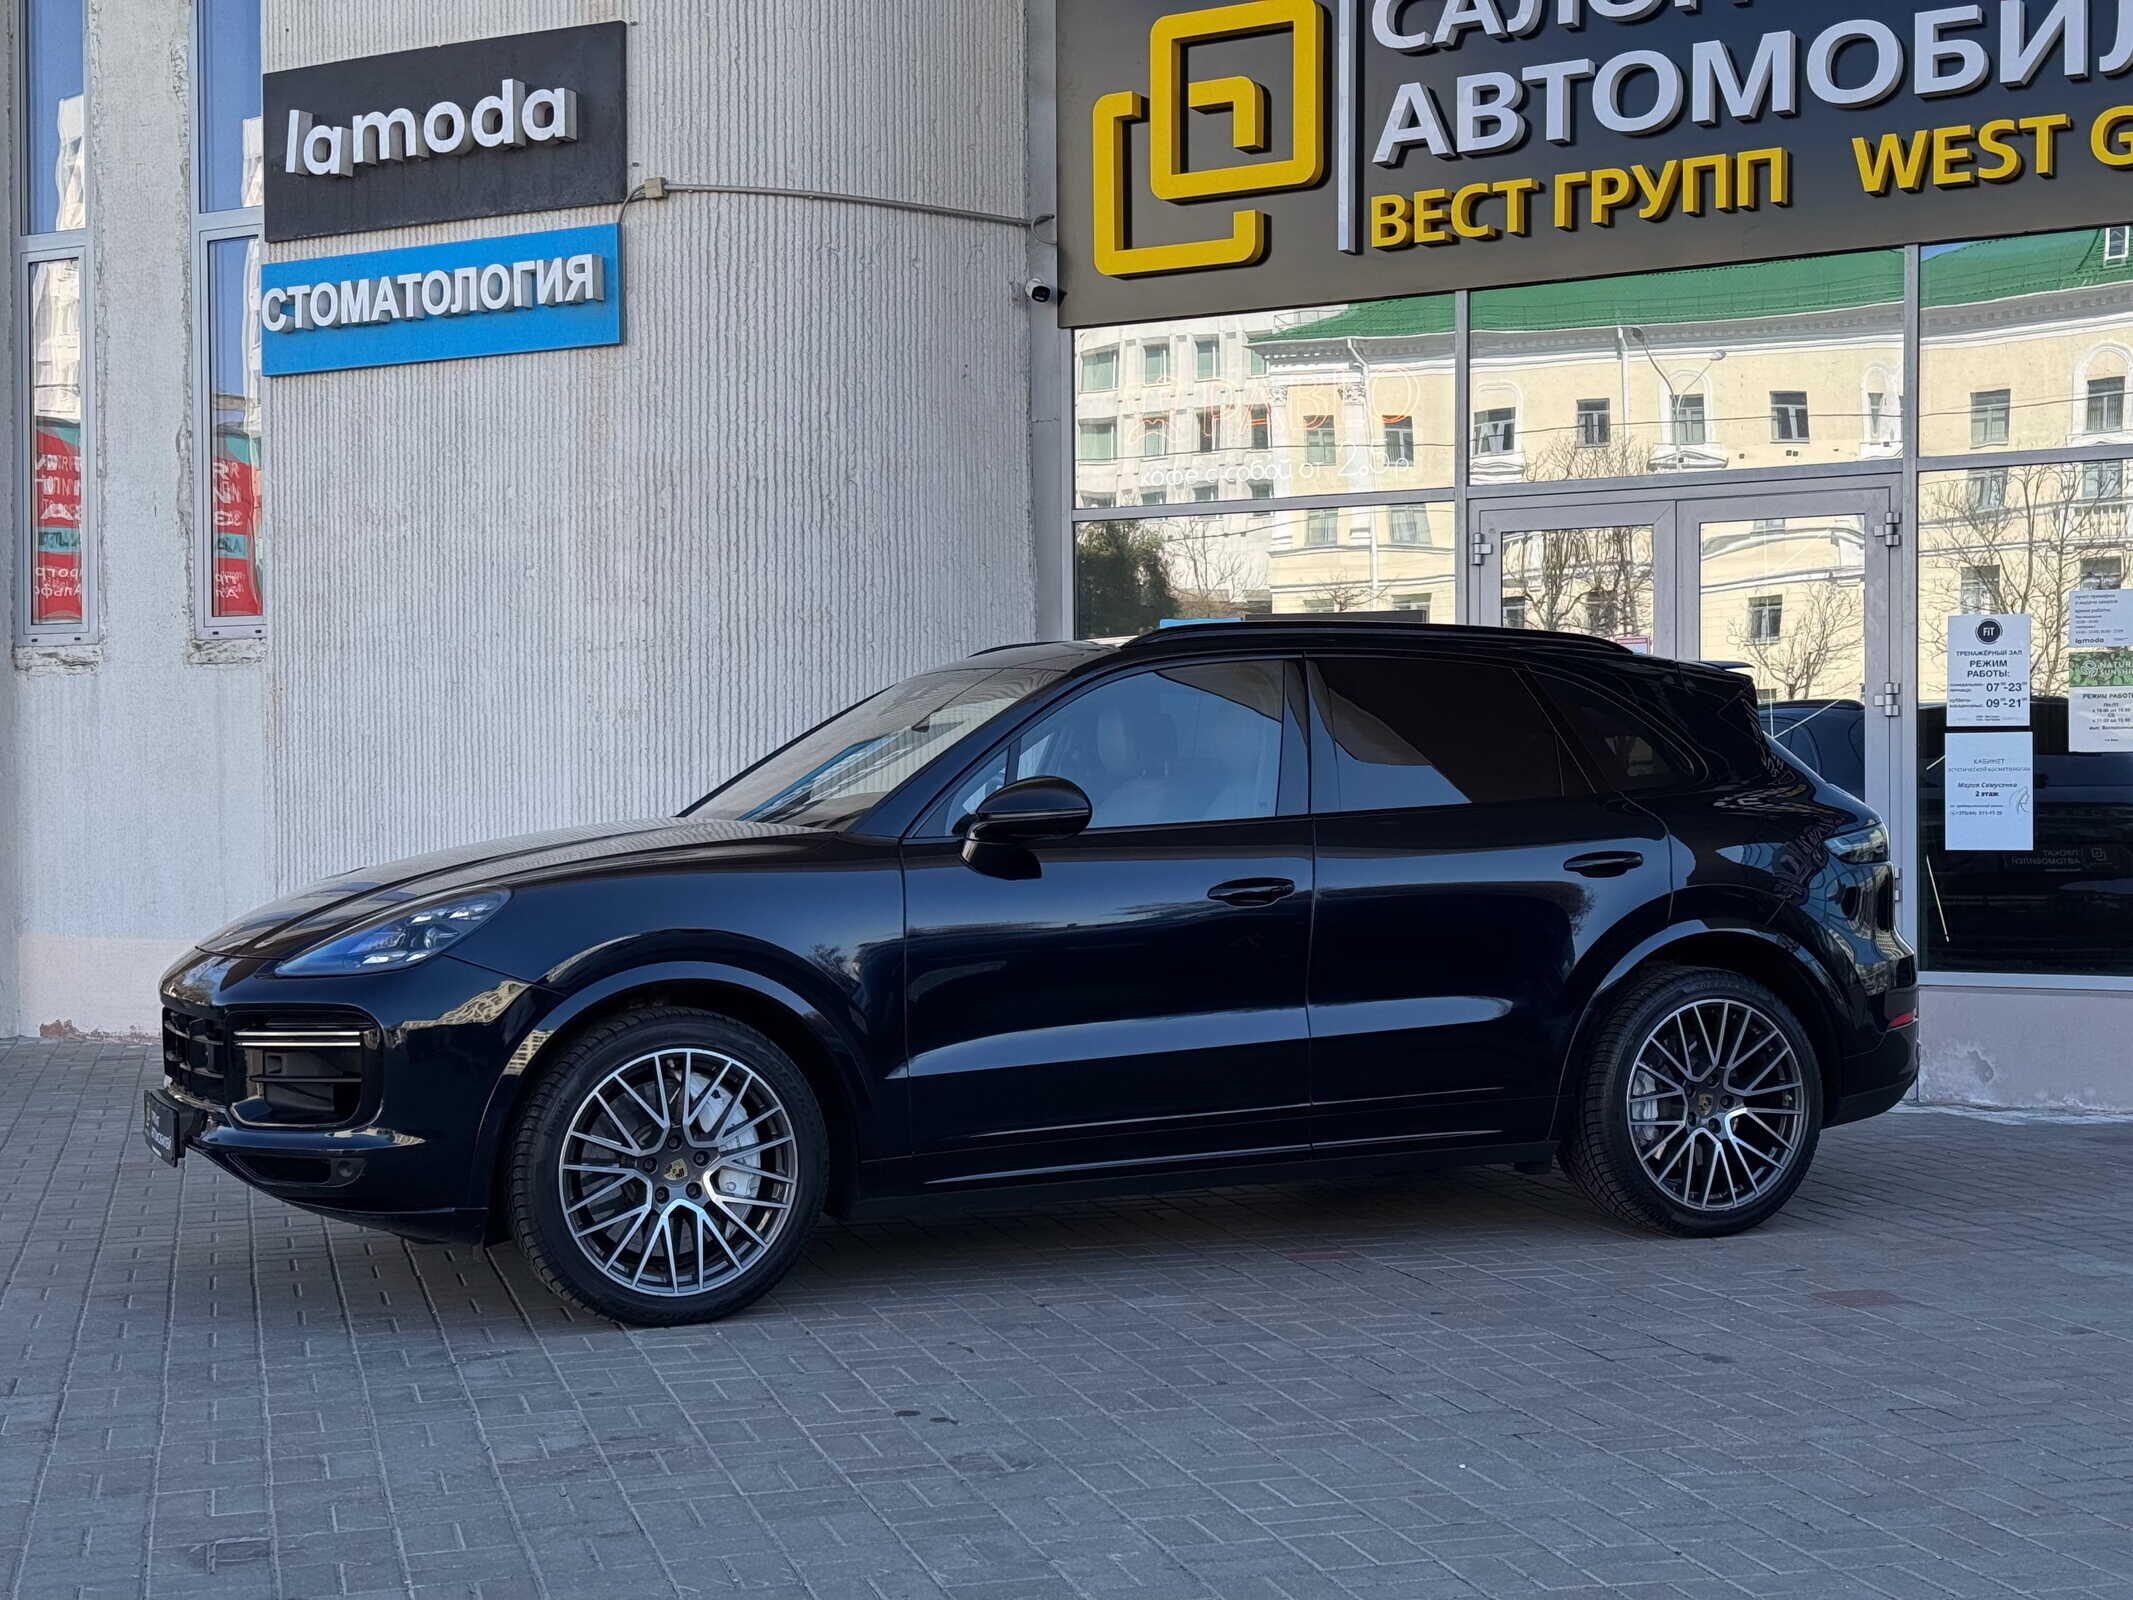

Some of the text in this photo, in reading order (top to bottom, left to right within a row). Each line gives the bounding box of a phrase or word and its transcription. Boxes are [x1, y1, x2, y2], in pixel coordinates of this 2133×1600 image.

[285, 78, 578, 178] lamoda
[1851, 113, 2072, 195] WEST
[1371, 146, 1790, 249] ВЕСТ ГРУПП
[261, 253, 604, 333] СТОМАТОЛОГИЯ
[1141, 465, 1199, 489] кофе
[1224, 458, 1293, 482] собой
[1983, 627, 1995, 636] FIT
[1967, 670, 2010, 678] РАБОТЫ:
[1969, 660, 2008, 668] РЕЖИМ
